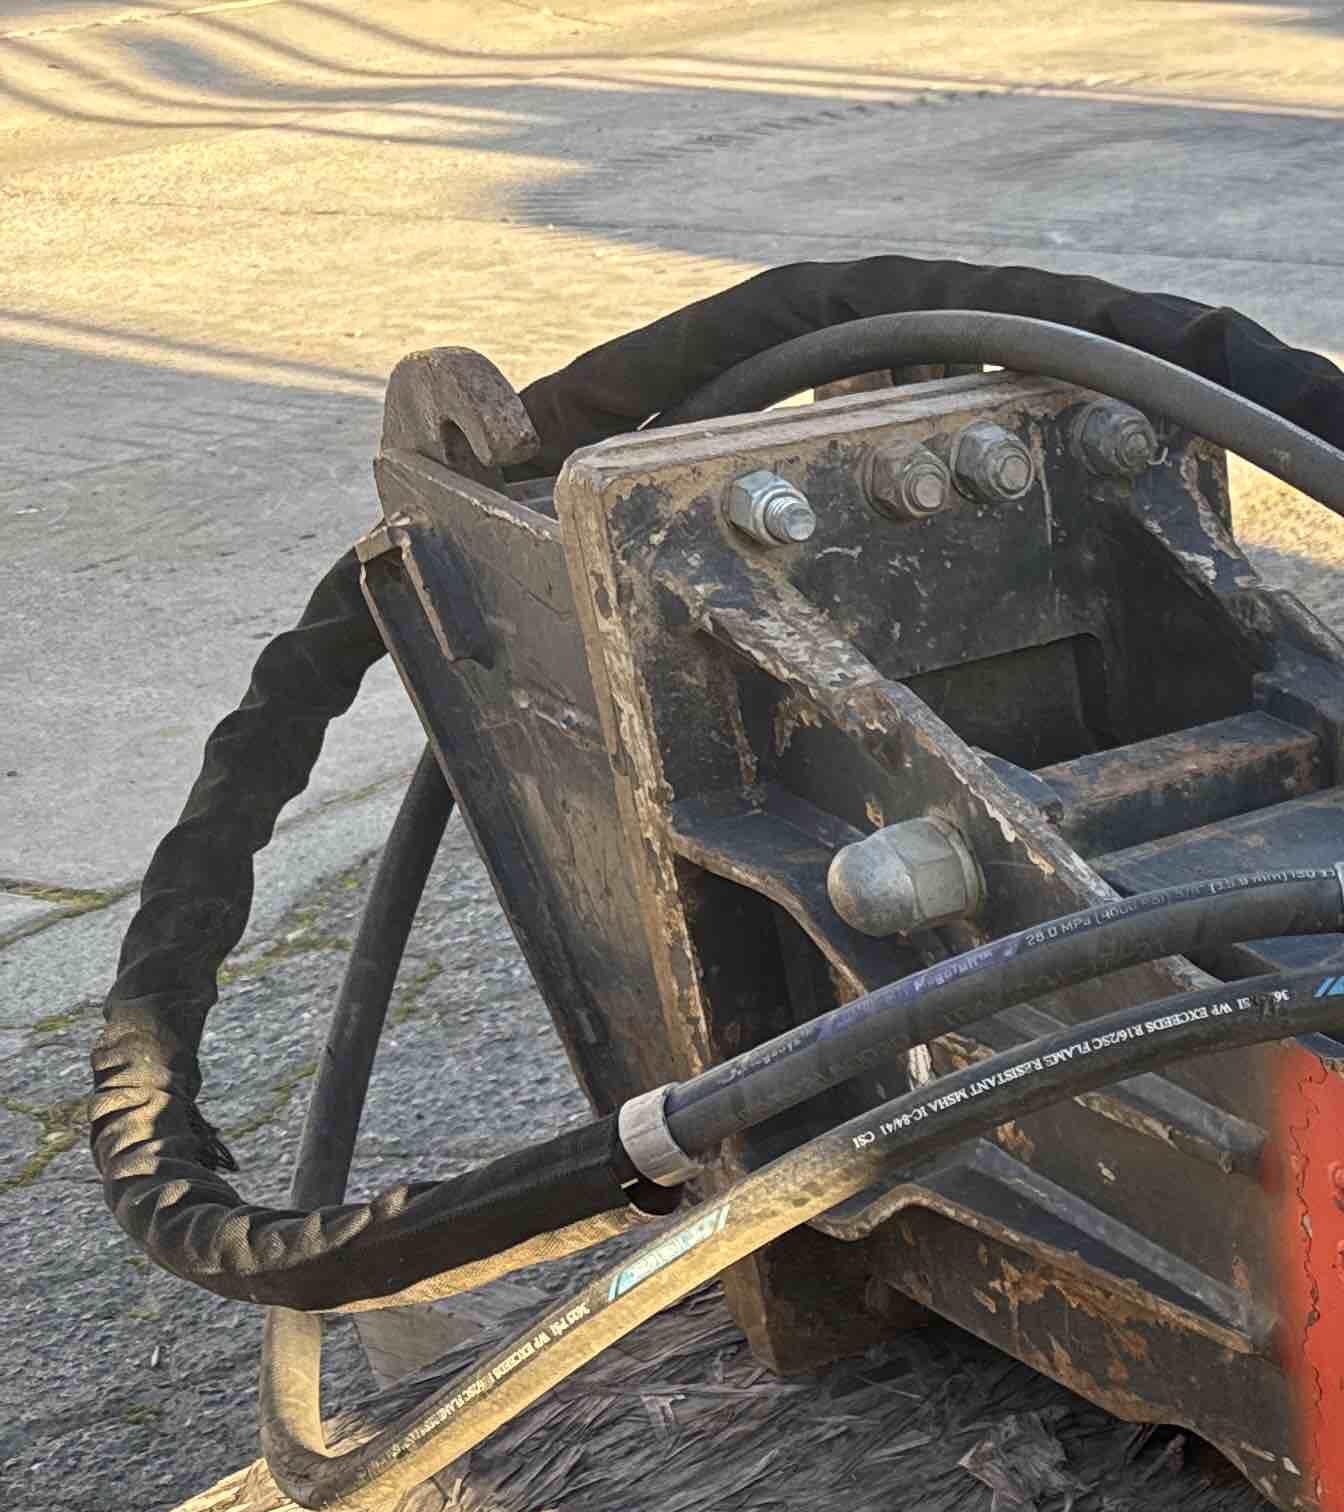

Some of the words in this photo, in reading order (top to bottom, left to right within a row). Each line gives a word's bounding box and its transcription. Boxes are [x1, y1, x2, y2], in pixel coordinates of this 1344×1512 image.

[1145, 1006, 1209, 1033] EXCEEDS
[1210, 1001, 1234, 1017] WP
[1093, 1026, 1144, 1050] R16/2SC
[1043, 1041, 1092, 1068] FLAME
[969, 1061, 1048, 1098] RESISTANT
[927, 1088, 970, 1113] MSHA
[879, 1105, 929, 1137] IC-84/41
[851, 1130, 876, 1150] CSI
